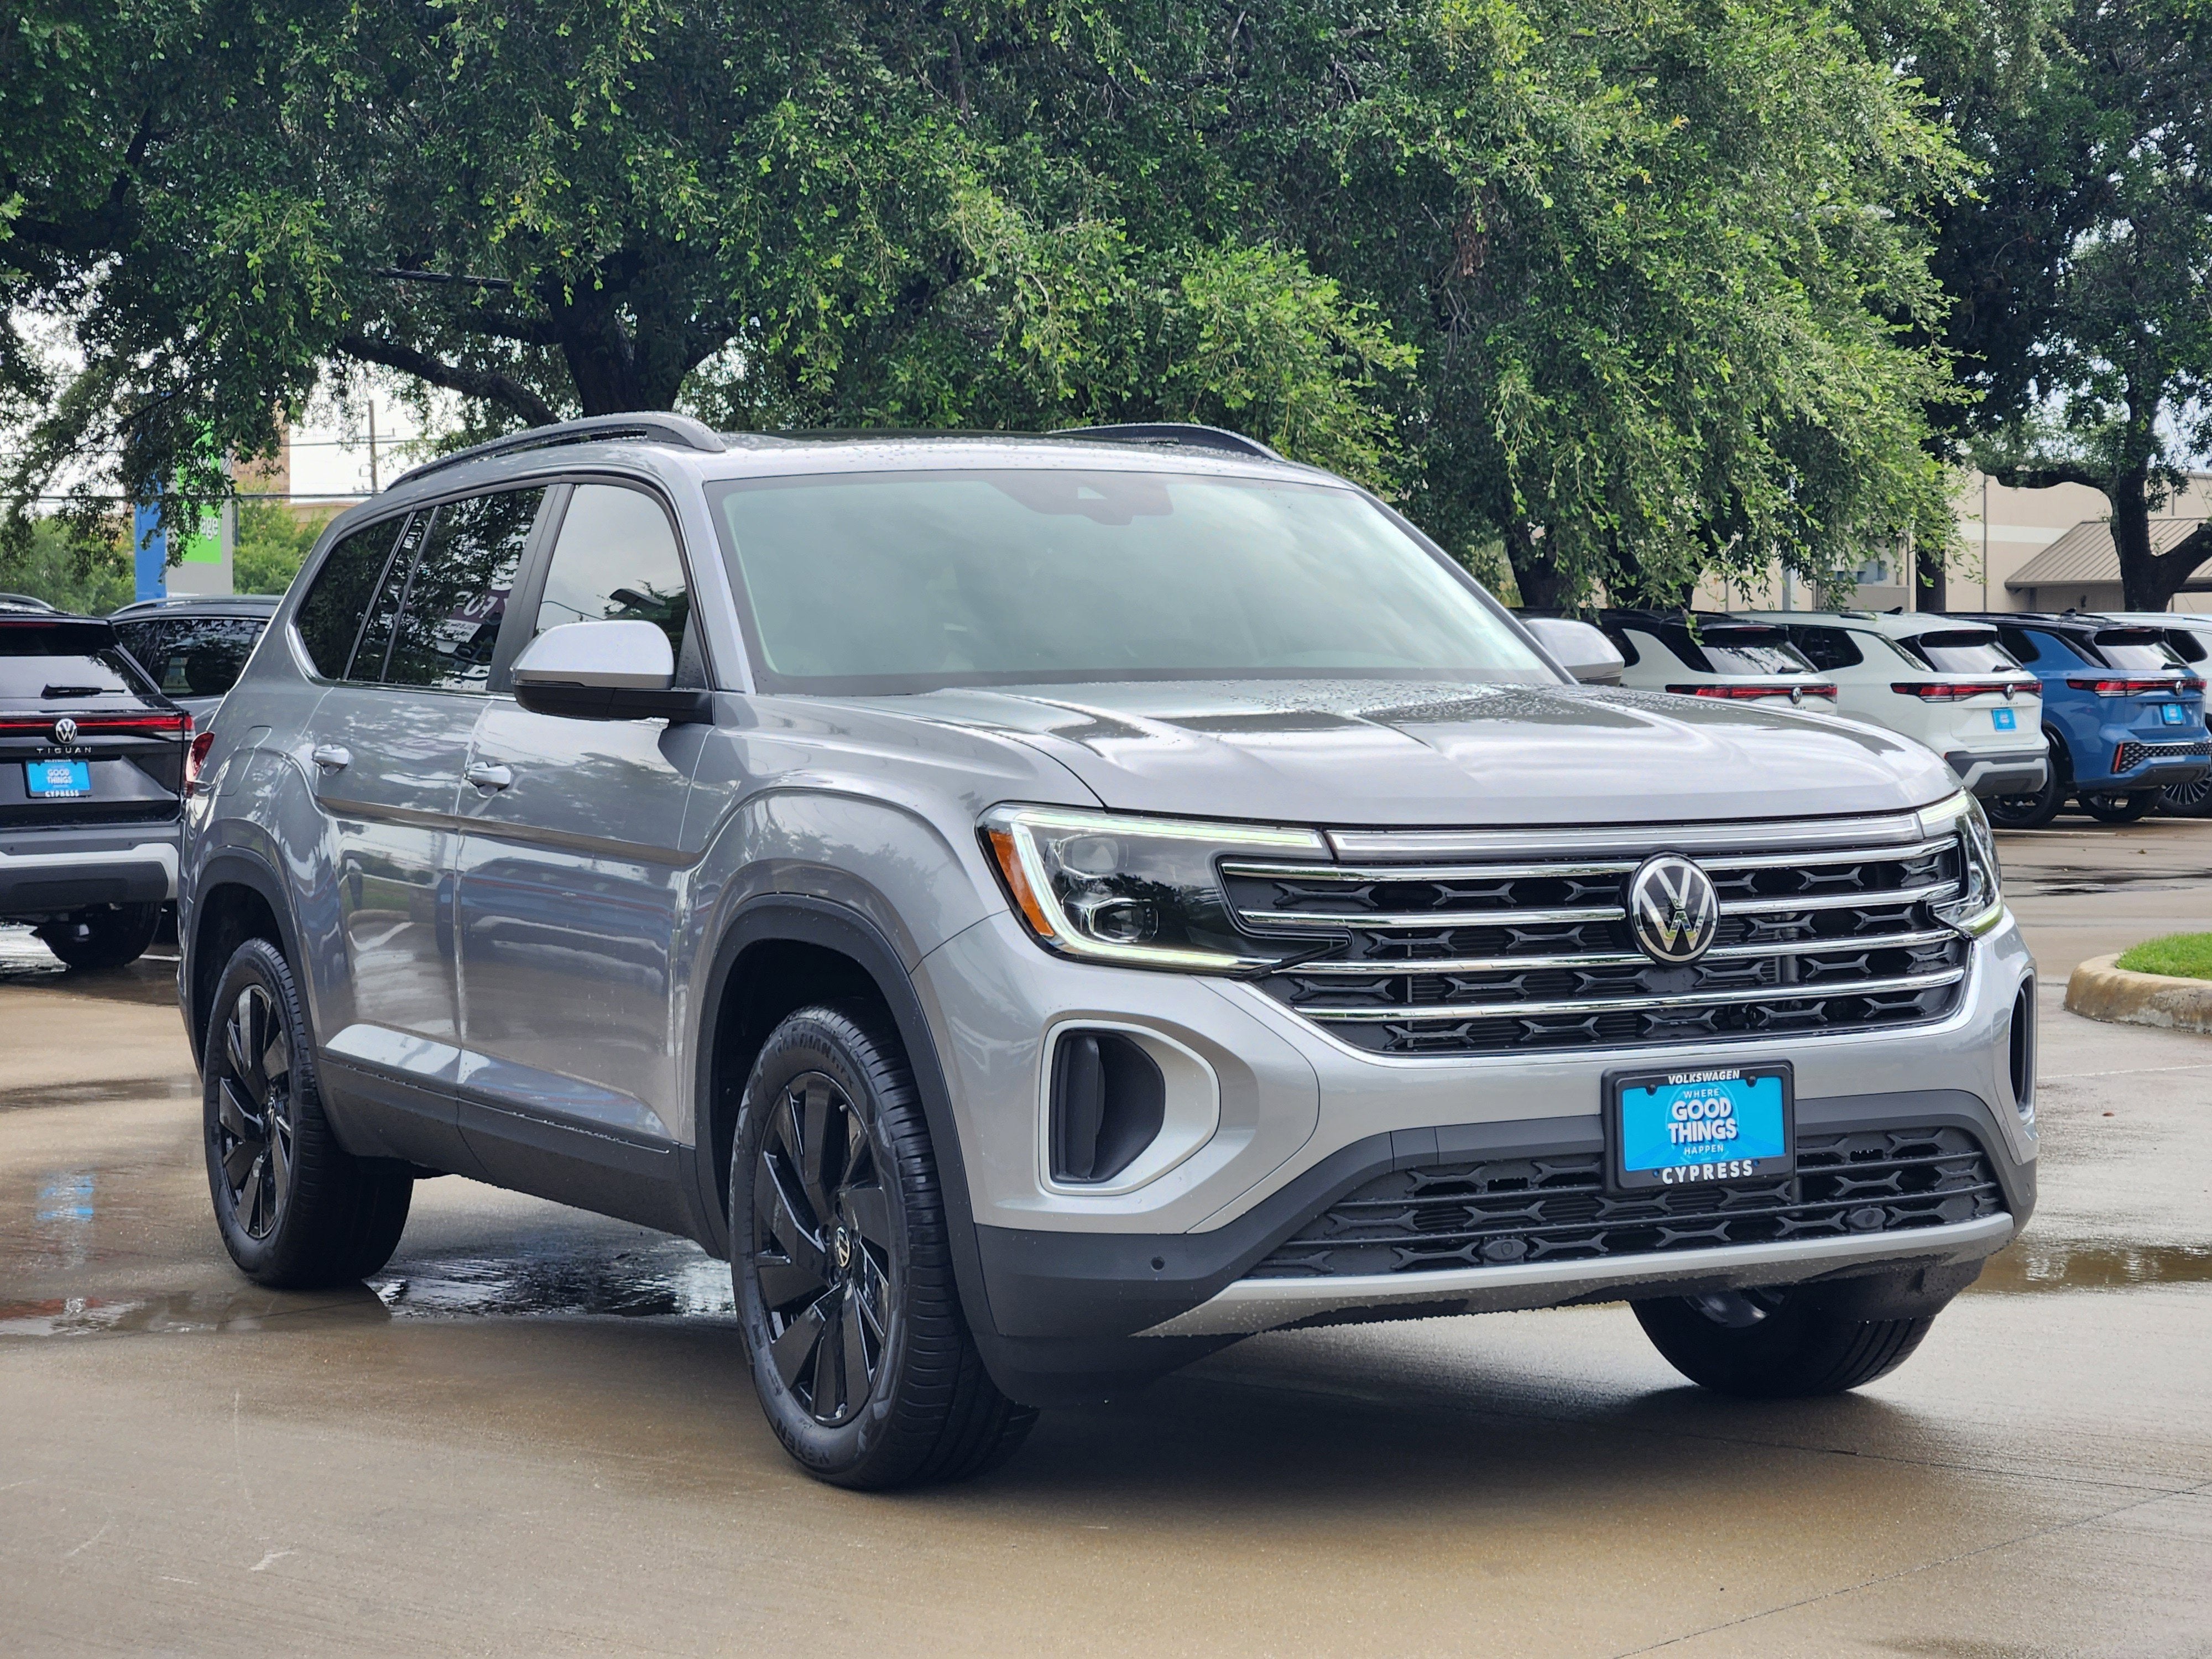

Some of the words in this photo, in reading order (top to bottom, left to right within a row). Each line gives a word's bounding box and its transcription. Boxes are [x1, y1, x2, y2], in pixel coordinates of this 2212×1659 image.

[1668, 1070, 1740, 1084] VOLKSWAGEN
[1683, 1088, 1720, 1098] WHERE
[1672, 1097, 1732, 1121] GOOD
[1667, 1118, 1737, 1143] THINGS
[1684, 1144, 1724, 1155] HAPPEN
[1662, 1160, 1752, 1184] CYPRESS
